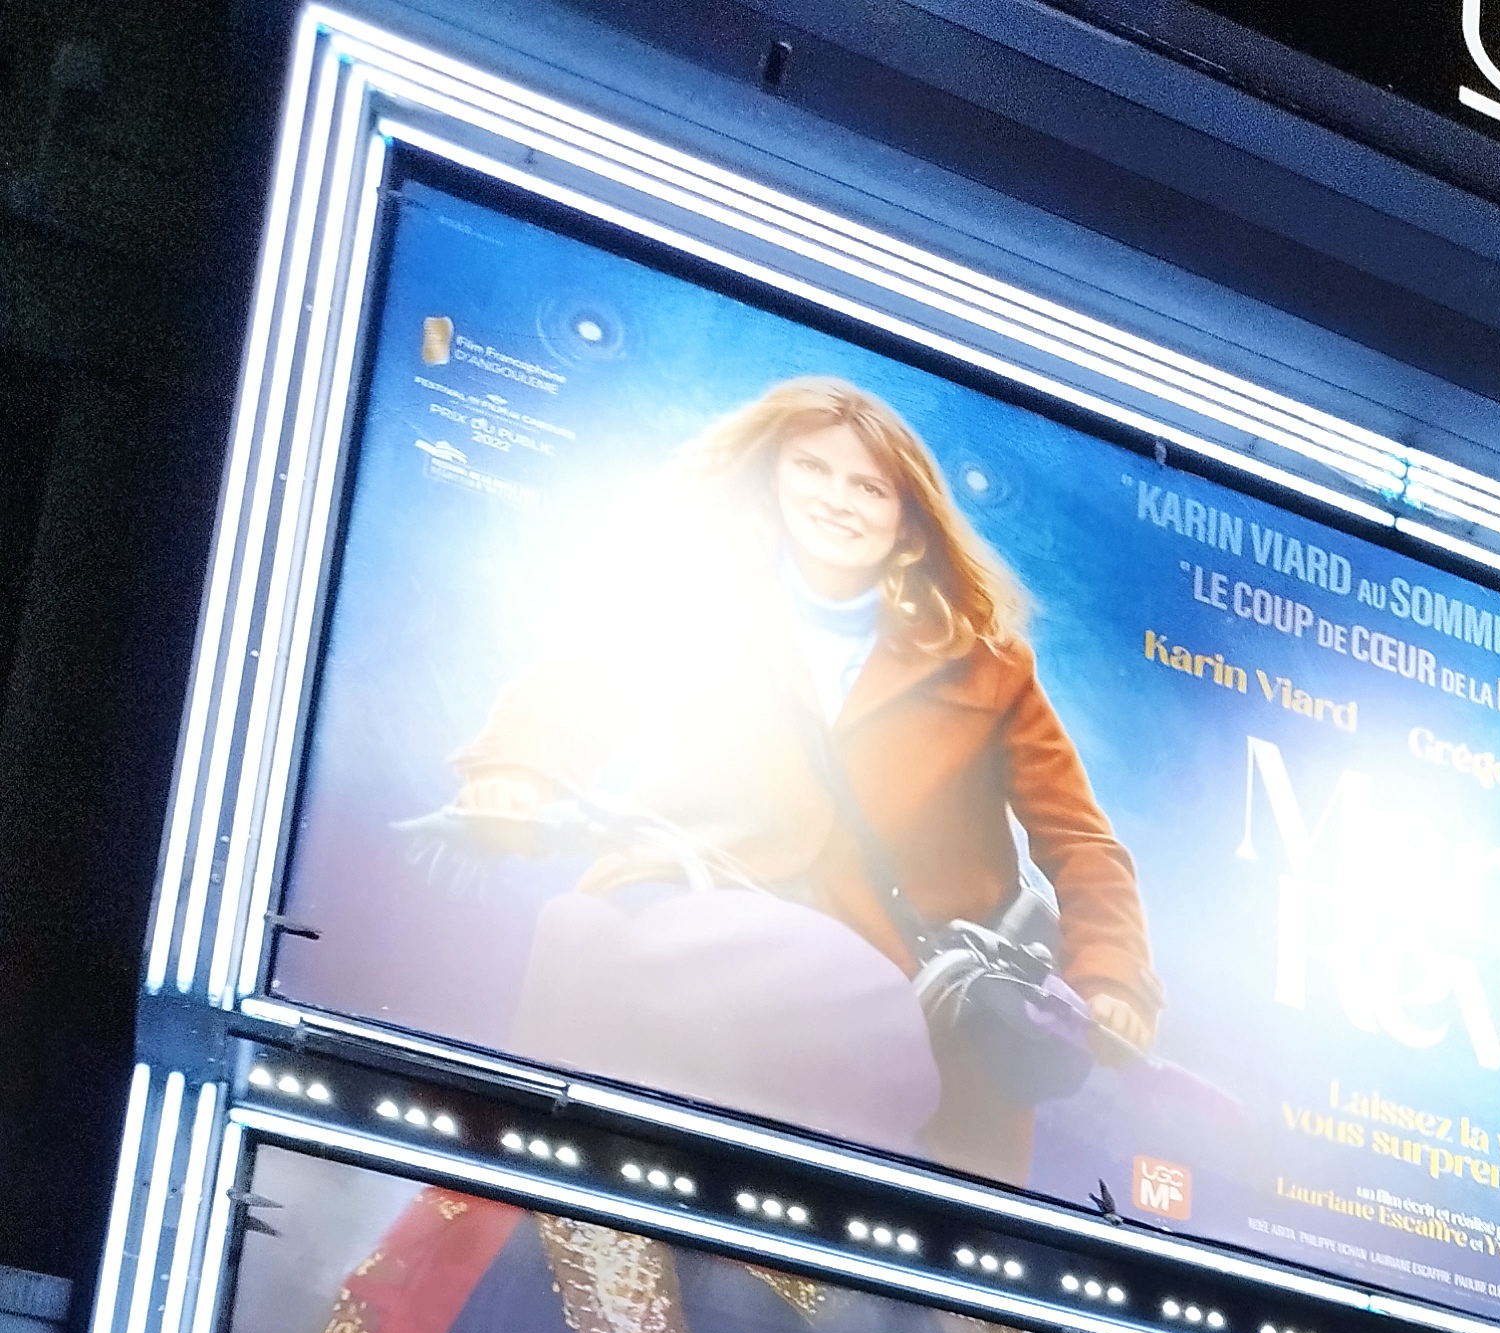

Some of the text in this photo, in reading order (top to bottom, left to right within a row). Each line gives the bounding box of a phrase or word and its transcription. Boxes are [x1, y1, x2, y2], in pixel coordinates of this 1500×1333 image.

[1250, 523, 1353, 597] VIARD
[1357, 578, 1387, 611] AU
[1144, 628, 1358, 734] Karin Viard
[1233, 580, 1313, 639] COUP
[1318, 620, 1348, 656] DE
[1441, 666, 1467, 698] DE
[1469, 675, 1495, 707] LA
[1328, 1080, 1454, 1144] Laissez
[1460, 1114, 1490, 1154] la
[1276, 1176, 1375, 1222] Lauriane
[1379, 1206, 1468, 1249] Escaffre
[1469, 1236, 1484, 1252] et
